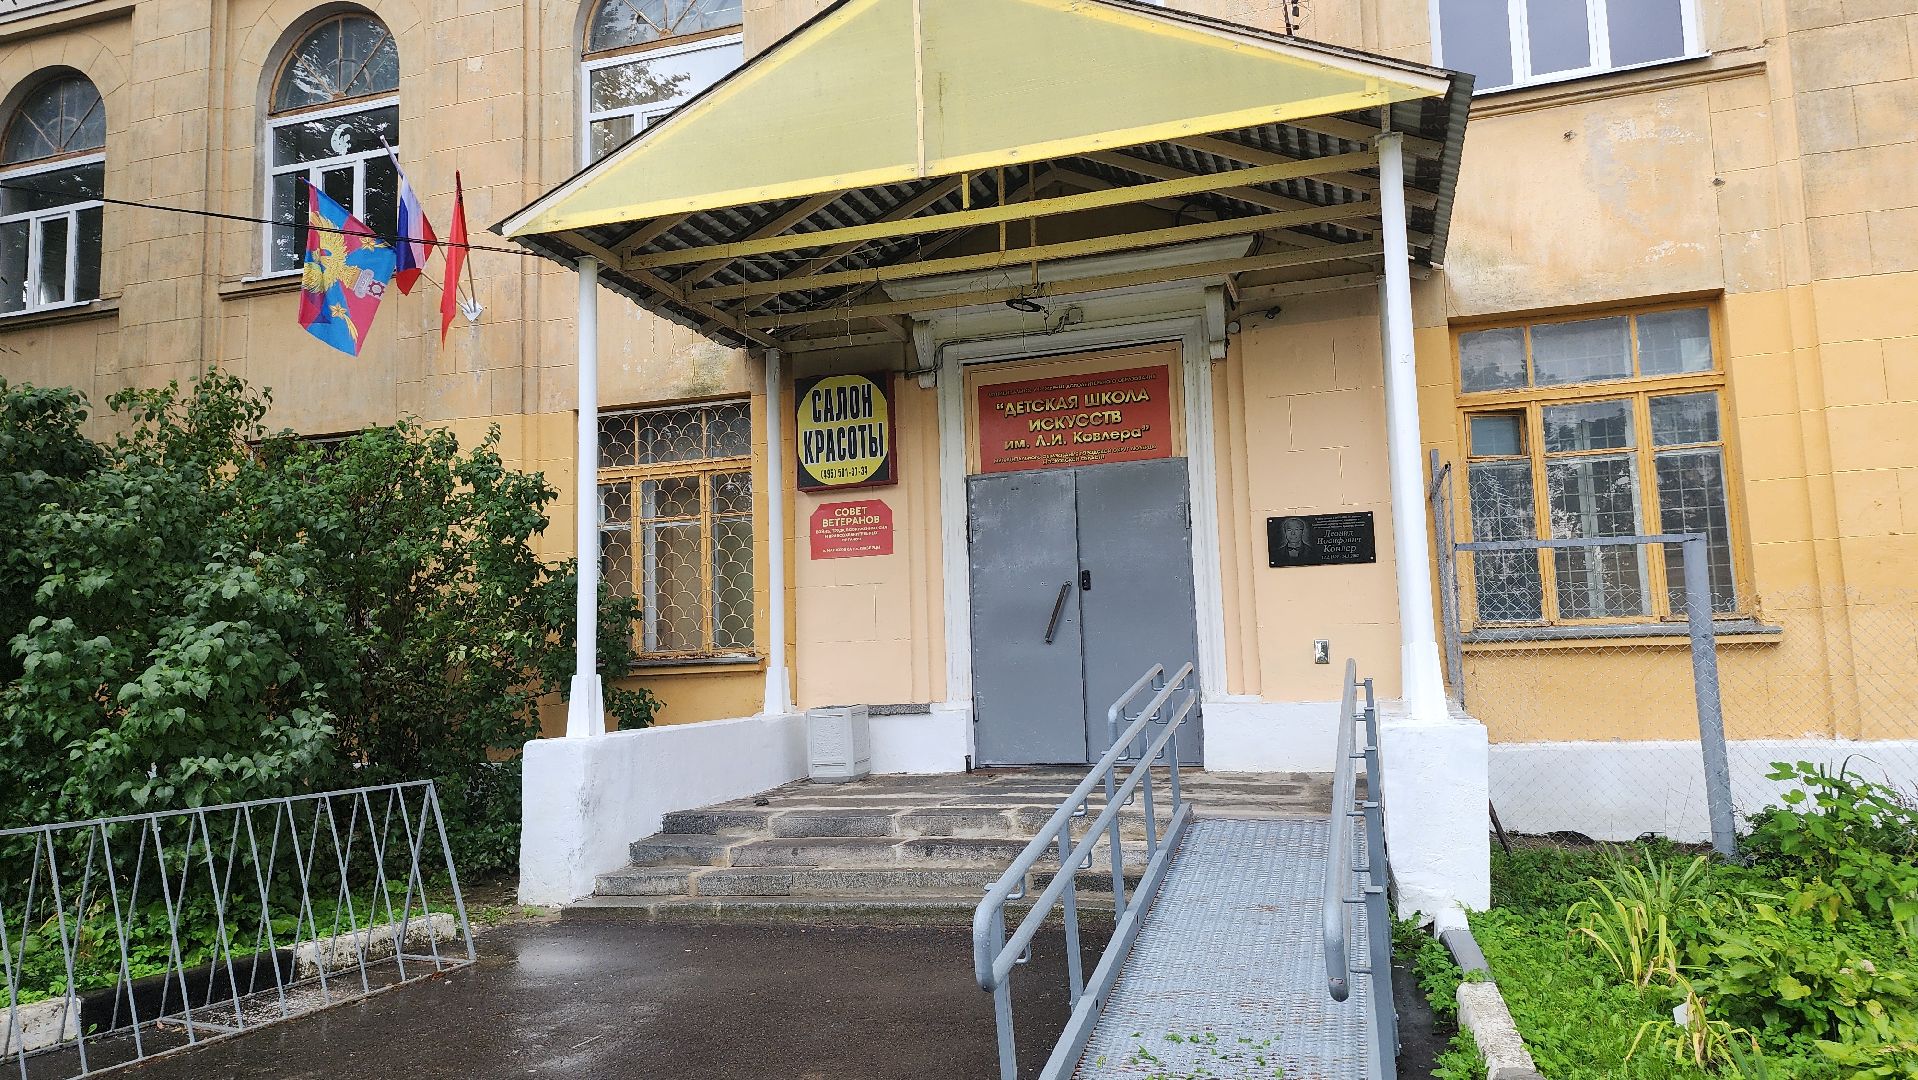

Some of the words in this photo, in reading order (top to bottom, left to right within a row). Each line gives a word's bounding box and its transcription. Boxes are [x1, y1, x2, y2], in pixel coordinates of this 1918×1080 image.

[811, 384, 872, 423] САЛОН
[1084, 388, 1150, 407] ШКОЛА
[1028, 410, 1122, 432] ИСКУССТВ
[803, 423, 884, 465] КРАСОТЫ
[1035, 433, 1067, 447] Л.И.
[834, 506, 868, 517] СОВЕТ
[822, 515, 880, 528] ВЕТЕРАНОВ
